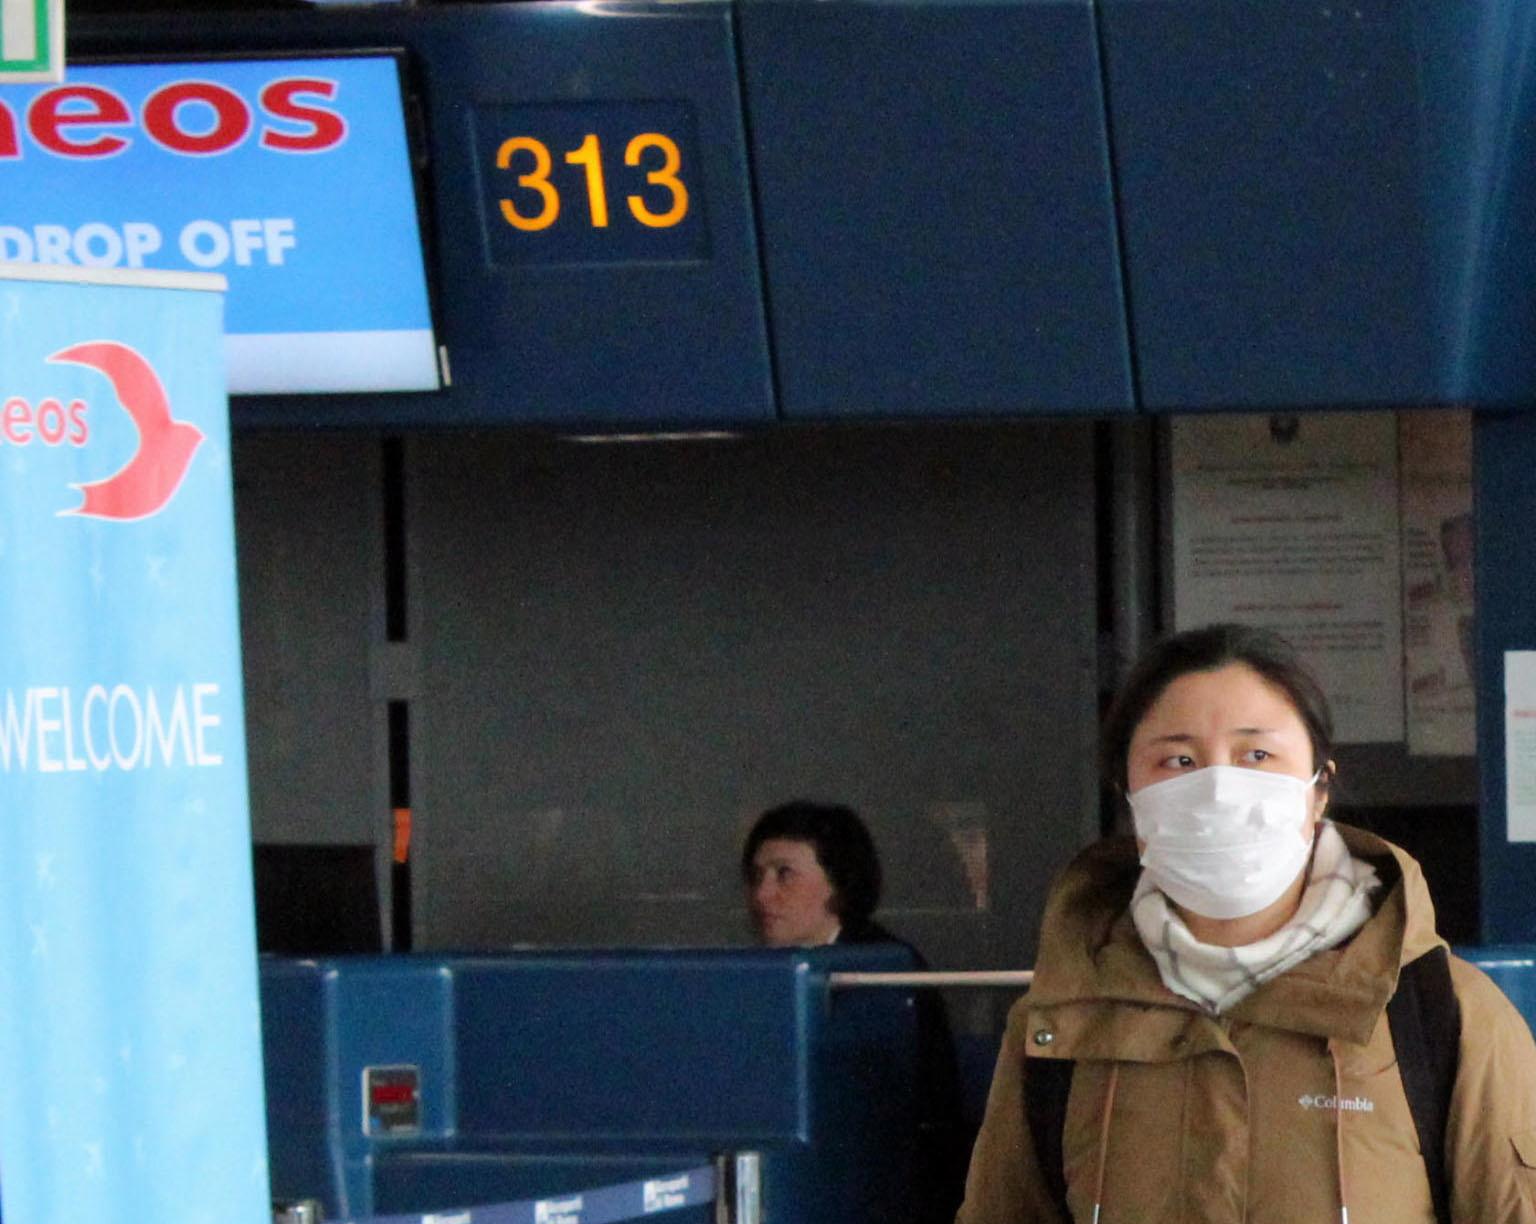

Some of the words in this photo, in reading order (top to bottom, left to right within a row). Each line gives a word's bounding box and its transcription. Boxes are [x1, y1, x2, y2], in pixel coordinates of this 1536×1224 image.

[0, 77, 348, 160] eos
[496, 132, 689, 231] 313
[0, 222, 162, 268] DROP
[179, 218, 296, 268] OFF
[0, 683, 223, 773] WELCOME
